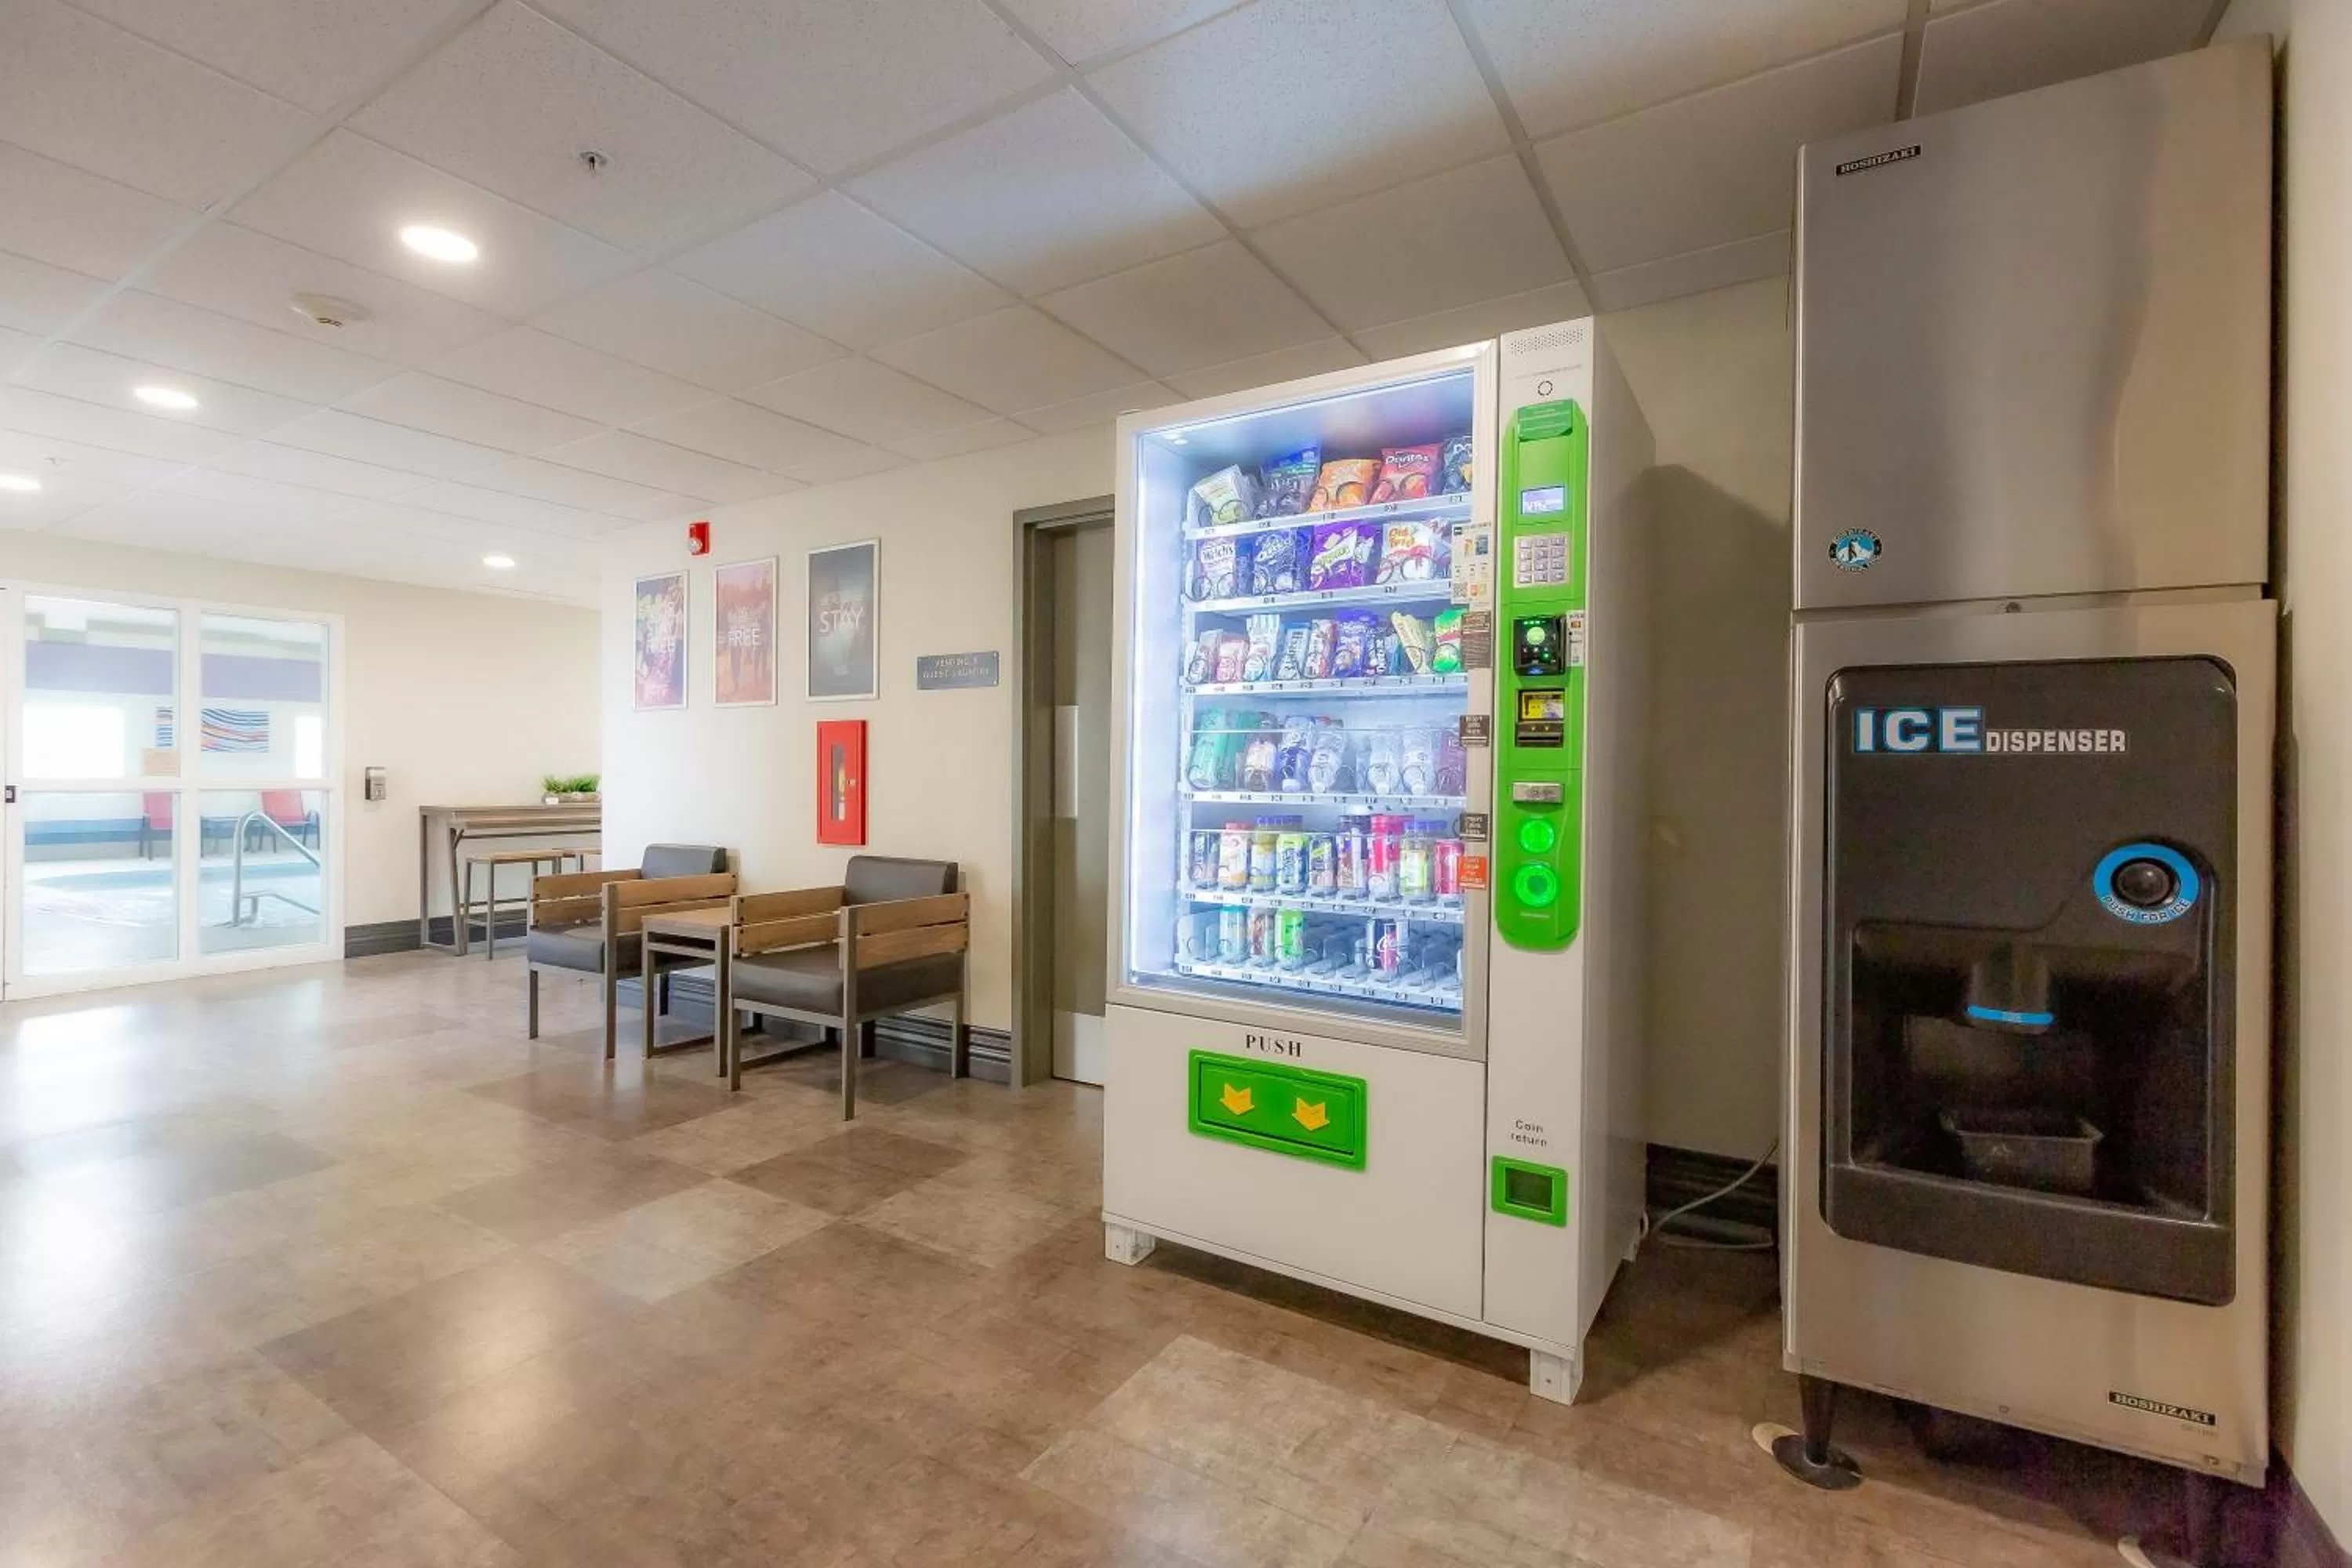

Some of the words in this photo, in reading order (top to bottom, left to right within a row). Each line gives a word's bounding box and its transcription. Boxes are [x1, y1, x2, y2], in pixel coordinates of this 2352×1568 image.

[1839, 147, 1915, 173] HOSHIZAKI
[1385, 453, 1430, 465] Doritos
[820, 606, 864, 633] STAY
[728, 628, 760, 648] FREE
[1856, 707, 1982, 753] ICE
[1986, 730, 2126, 753] DISPENSER
[2102, 895, 2135, 920] PUSH
[2141, 912, 2168, 922] FOR
[2170, 898, 2191, 917] ICE
[1246, 1034, 1302, 1058] PUSH
[1515, 1119, 1544, 1133] Coin
[1511, 1132, 1548, 1148] return
[2114, 1392, 2210, 1424] HOSHIZAKI
